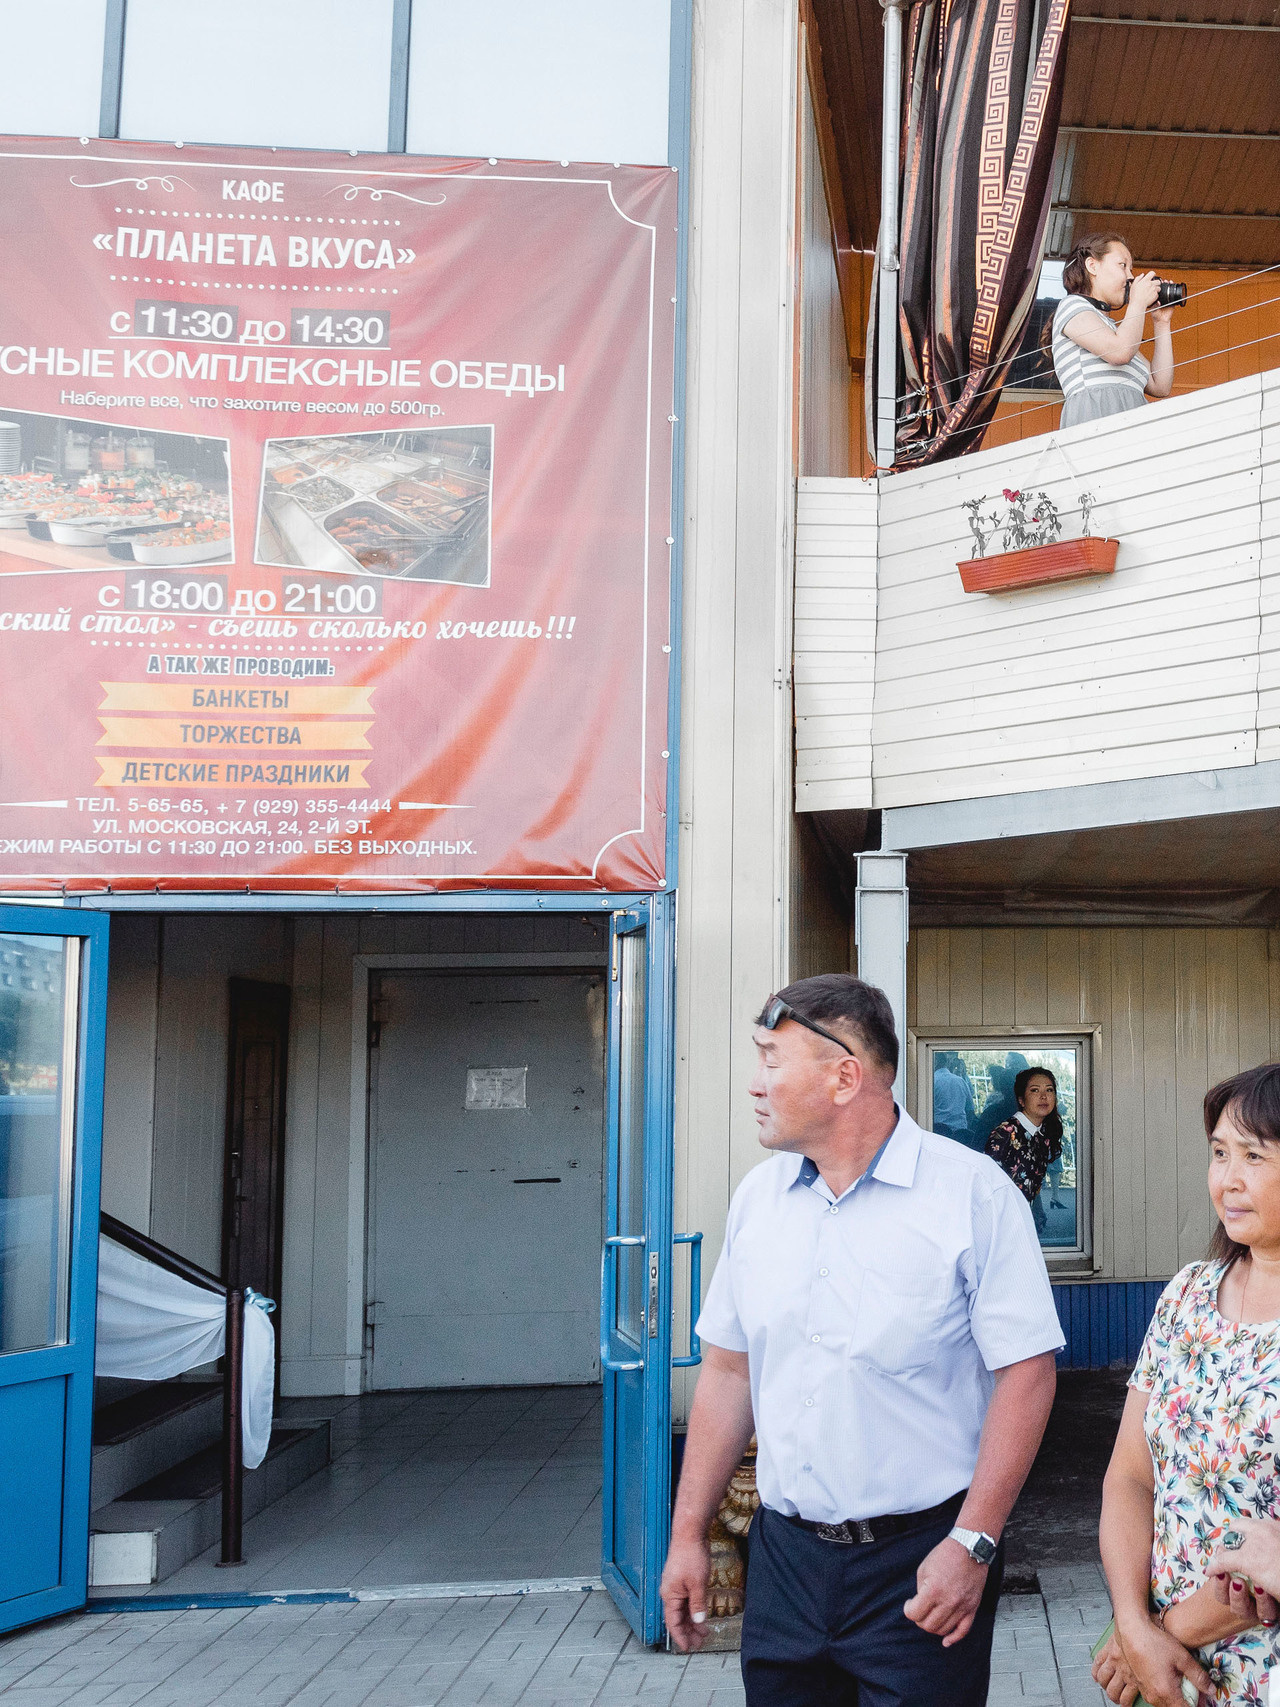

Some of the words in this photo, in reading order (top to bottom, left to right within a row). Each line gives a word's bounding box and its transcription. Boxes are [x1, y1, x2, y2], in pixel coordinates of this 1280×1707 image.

[222, 179, 285, 203] КАФЕ
[92, 226, 277, 267] «ПЛАНЕТА
[288, 236, 417, 270] ВКУСА»
[141, 306, 233, 340] 11:30
[296, 315, 384, 344] 14:30
[0, 345, 114, 378] СНЫЕ
[123, 349, 422, 387] КОМПЛЕКСНЫЕ
[429, 359, 566, 398] ОБЕДЫ
[60, 390, 146, 409] Наберите
[149, 395, 184, 410] все,
[189, 396, 220, 409] что
[222, 397, 301, 412] захотите
[305, 400, 360, 415] весом
[362, 402, 386, 417] до
[390, 401, 446, 417] 500гр.
[131, 579, 224, 611] 18:00
[284, 583, 376, 613] 21:00
[0, 607, 72, 632] ский
[80, 616, 176, 635] стол»
[208, 618, 299, 638] съешь
[308, 619, 427, 639] сколько
[436, 616, 577, 640] хочешь!!!
[147, 655, 161, 673] А
[165, 655, 199, 674] ТАК
[202, 656, 230, 675] ЖЕ
[234, 657, 335, 679] ПРОВОДИМ:
[192, 689, 289, 708] БАНКЕТЫ
[180, 724, 302, 745] ТОРЖЕСТВА
[121, 762, 219, 783] ДЕТСКИЕ
[225, 764, 350, 785] ПРАЗДНИКИ
[75, 797, 121, 812] ТЕЛ.
[127, 798, 209, 815] 5-65-65,
[236, 800, 247, 813] 7
[253, 800, 299, 817] (929)
[305, 799, 392, 813] 355-4444
[92, 819, 122, 834] УЛ.
[128, 819, 272, 836] МОСКОВСКАЯ,
[277, 820, 303, 836] 24,
[308, 817, 340, 834] 2-Й
[345, 820, 373, 834] ЭТ.
[0, 839, 54, 854] ЖИМ
[59, 839, 141, 854] РАБОТЫ
[147, 839, 162, 854] С
[168, 840, 216, 855] 11:30
[220, 840, 250, 858] ДО
[254, 840, 308, 855] 21:00.
[314, 840, 353, 855] БЕЗ
[358, 840, 478, 858] ВЫХОДНЫХ.
